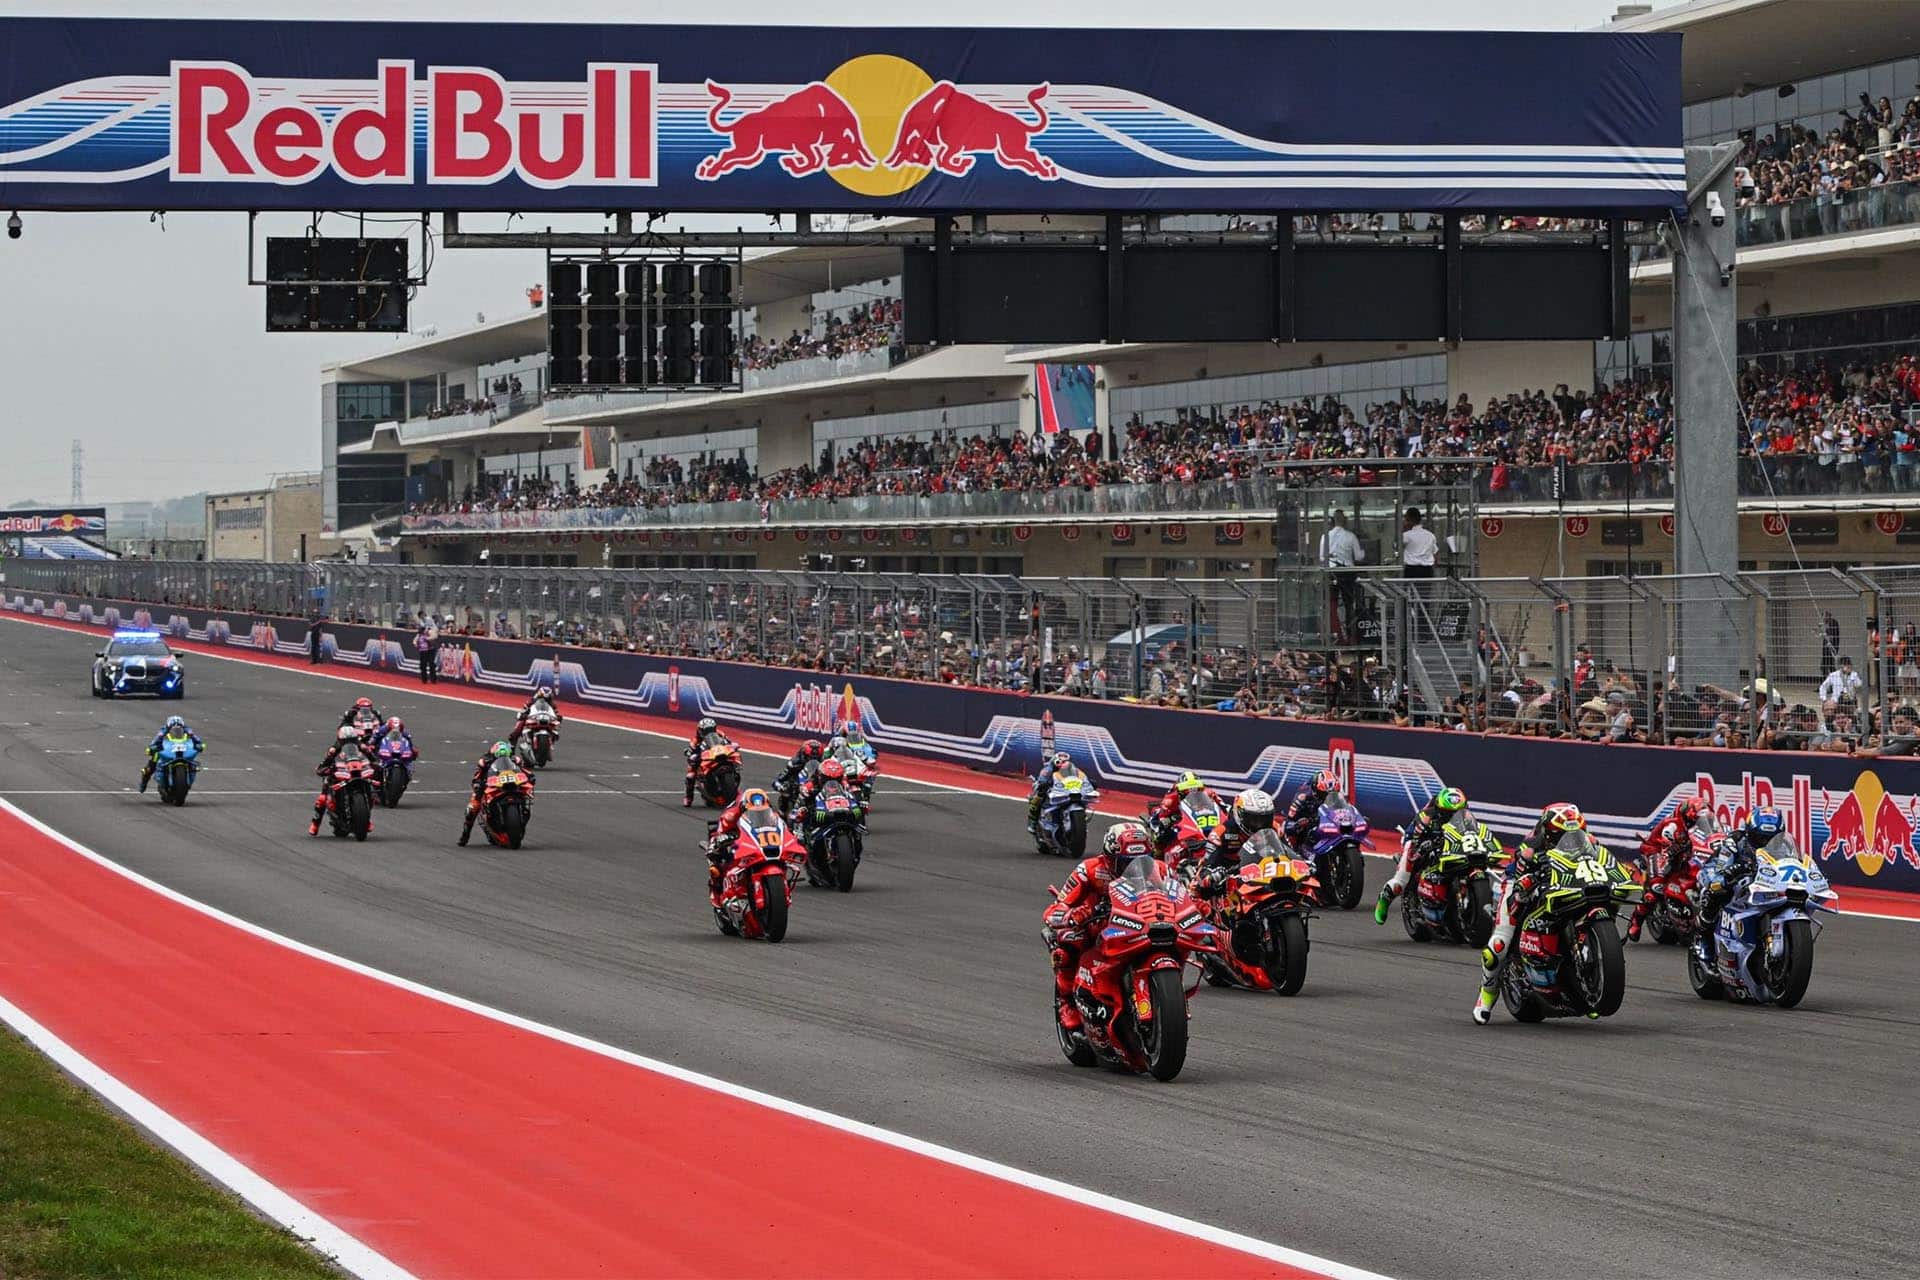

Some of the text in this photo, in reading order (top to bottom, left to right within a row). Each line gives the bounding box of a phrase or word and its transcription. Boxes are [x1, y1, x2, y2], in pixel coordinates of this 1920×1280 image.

[176, 65, 652, 182] Red Bull
[15, 516, 41, 531] Bull
[1486, 519, 1499, 533] 25
[1571, 518, 1585, 532] 26
[1768, 516, 1783, 531] 28
[1882, 513, 1897, 530] 29
[1229, 524, 1241, 536] 23
[1196, 815, 1220, 828] 36
[757, 832, 781, 847] 10
[1462, 834, 1487, 854] 21
[1263, 861, 1292, 878] 37
[1574, 859, 1609, 884] 49
[1778, 865, 1808, 883] 73
[1136, 898, 1176, 922] 93
[1111, 915, 1143, 930] Lenovo
